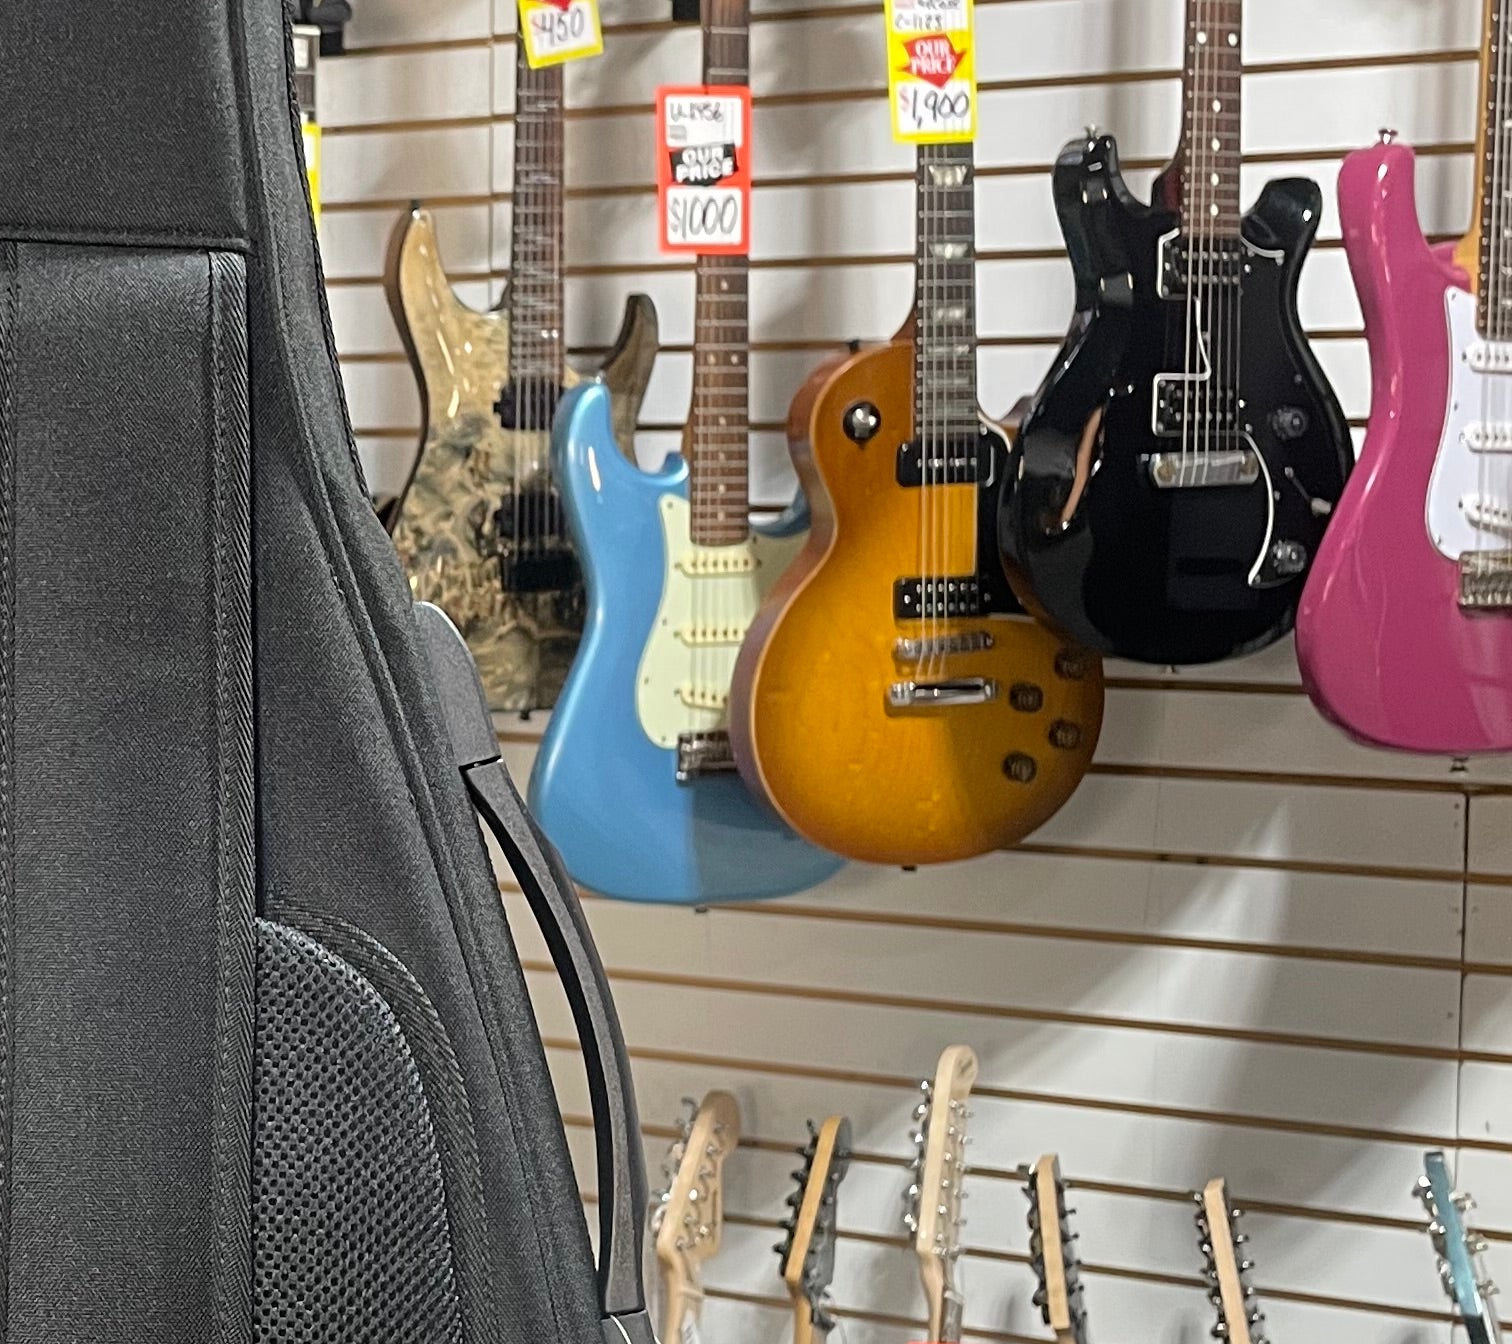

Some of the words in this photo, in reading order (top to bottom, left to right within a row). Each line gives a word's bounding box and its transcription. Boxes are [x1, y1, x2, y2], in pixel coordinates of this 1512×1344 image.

[915, 39, 951, 58] OUR
[911, 56, 956, 75] PRICE
[899, 87, 970, 129] $1,900
[682, 147, 724, 166] OUR
[676, 157, 734, 183] PRICE
[668, 194, 738, 240] $1000
